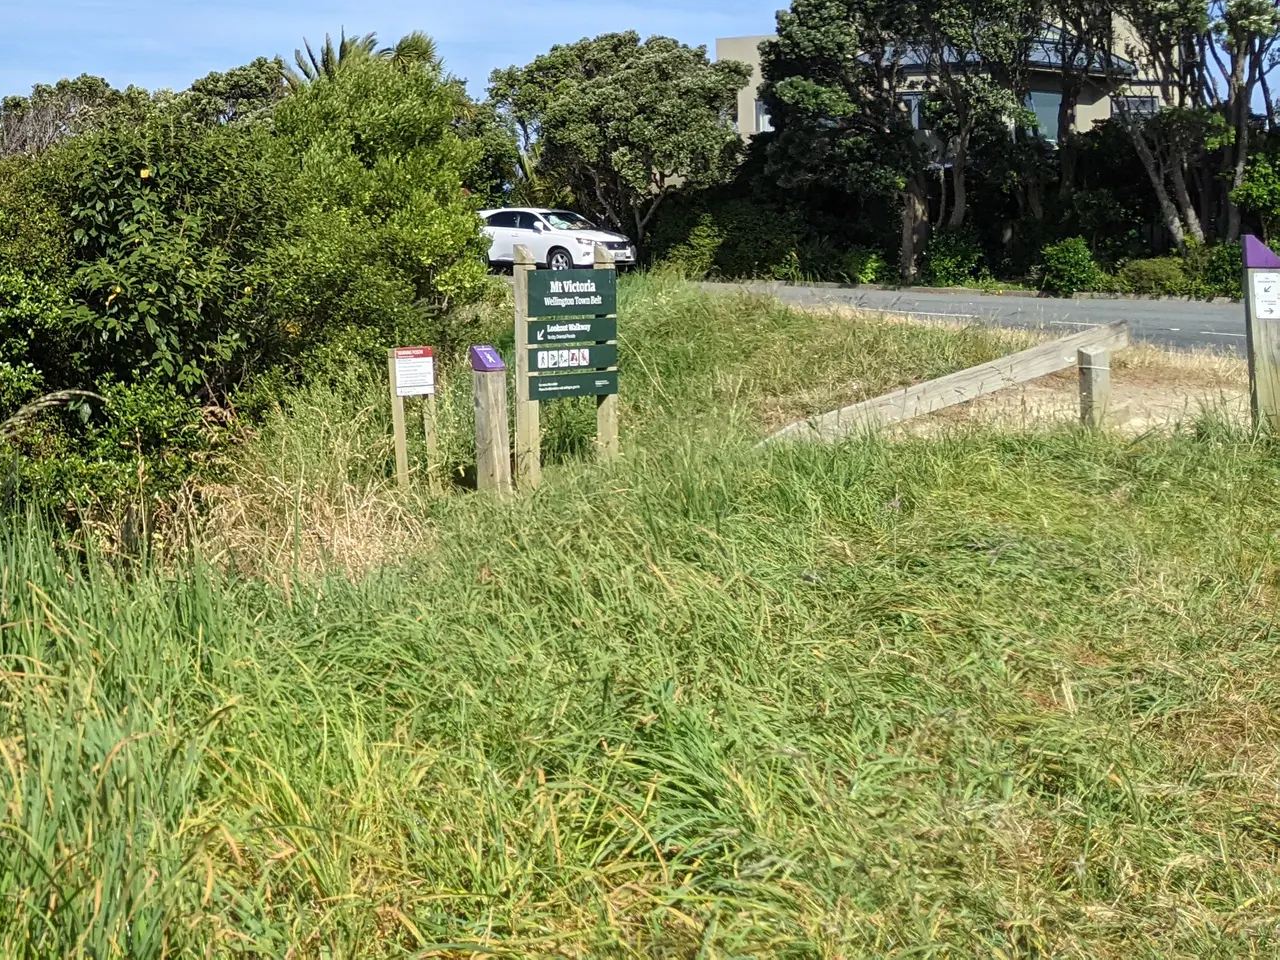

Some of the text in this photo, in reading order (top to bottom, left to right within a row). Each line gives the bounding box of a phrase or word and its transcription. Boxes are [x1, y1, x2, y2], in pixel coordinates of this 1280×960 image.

[550, 279, 596, 293] Mt Victoria
[544, 294, 602, 308] Wellington Town Belt
